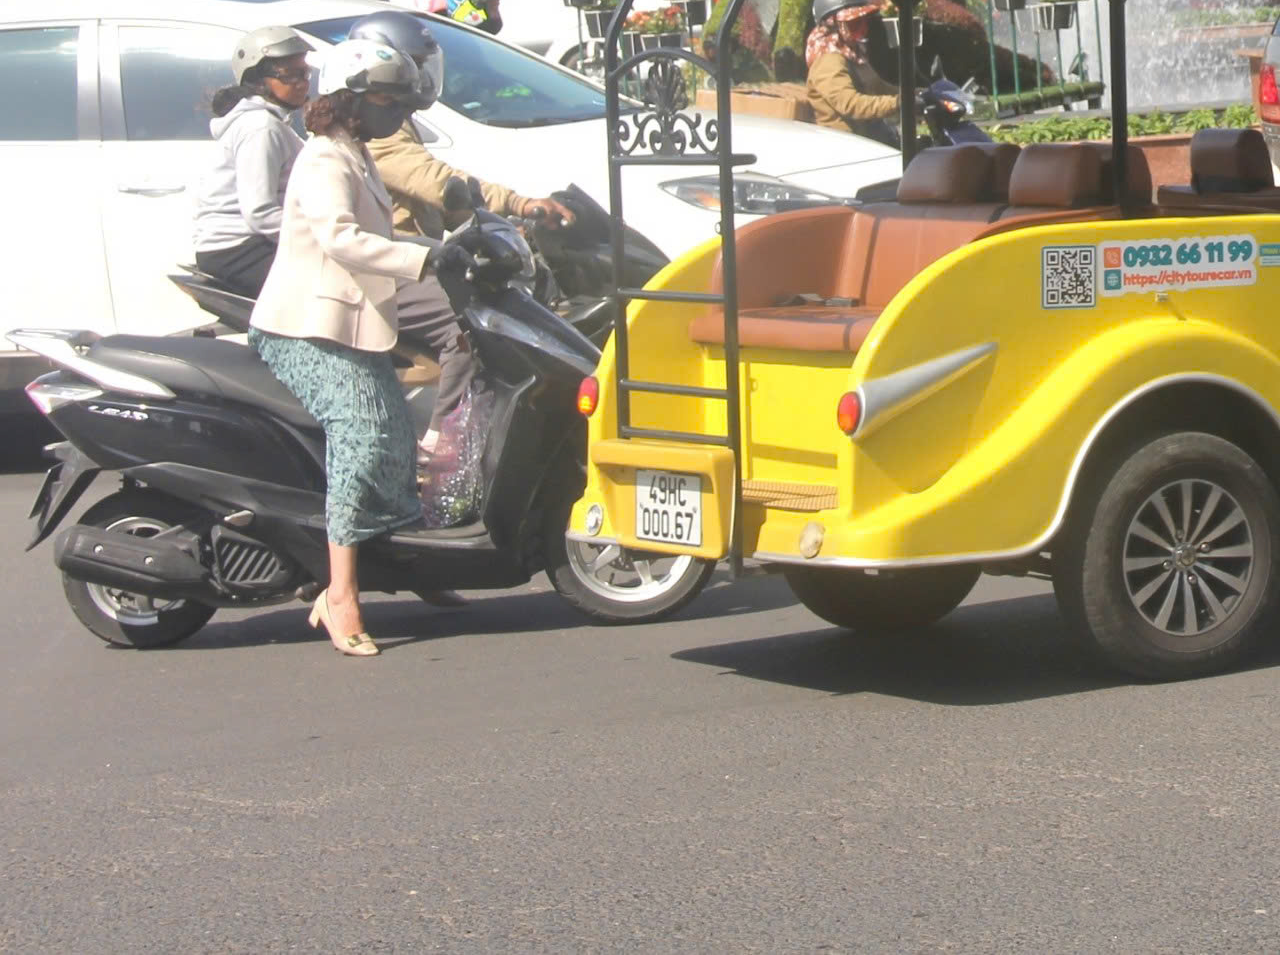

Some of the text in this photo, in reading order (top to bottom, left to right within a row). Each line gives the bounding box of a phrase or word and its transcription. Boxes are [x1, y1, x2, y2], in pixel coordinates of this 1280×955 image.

[1123, 240, 1253, 267] 0932 66 11 99
[1123, 268, 1252, 288] https://citytourecar.vn
[649, 474, 687, 507] 49HC
[643, 507, 694, 541] 000.67
